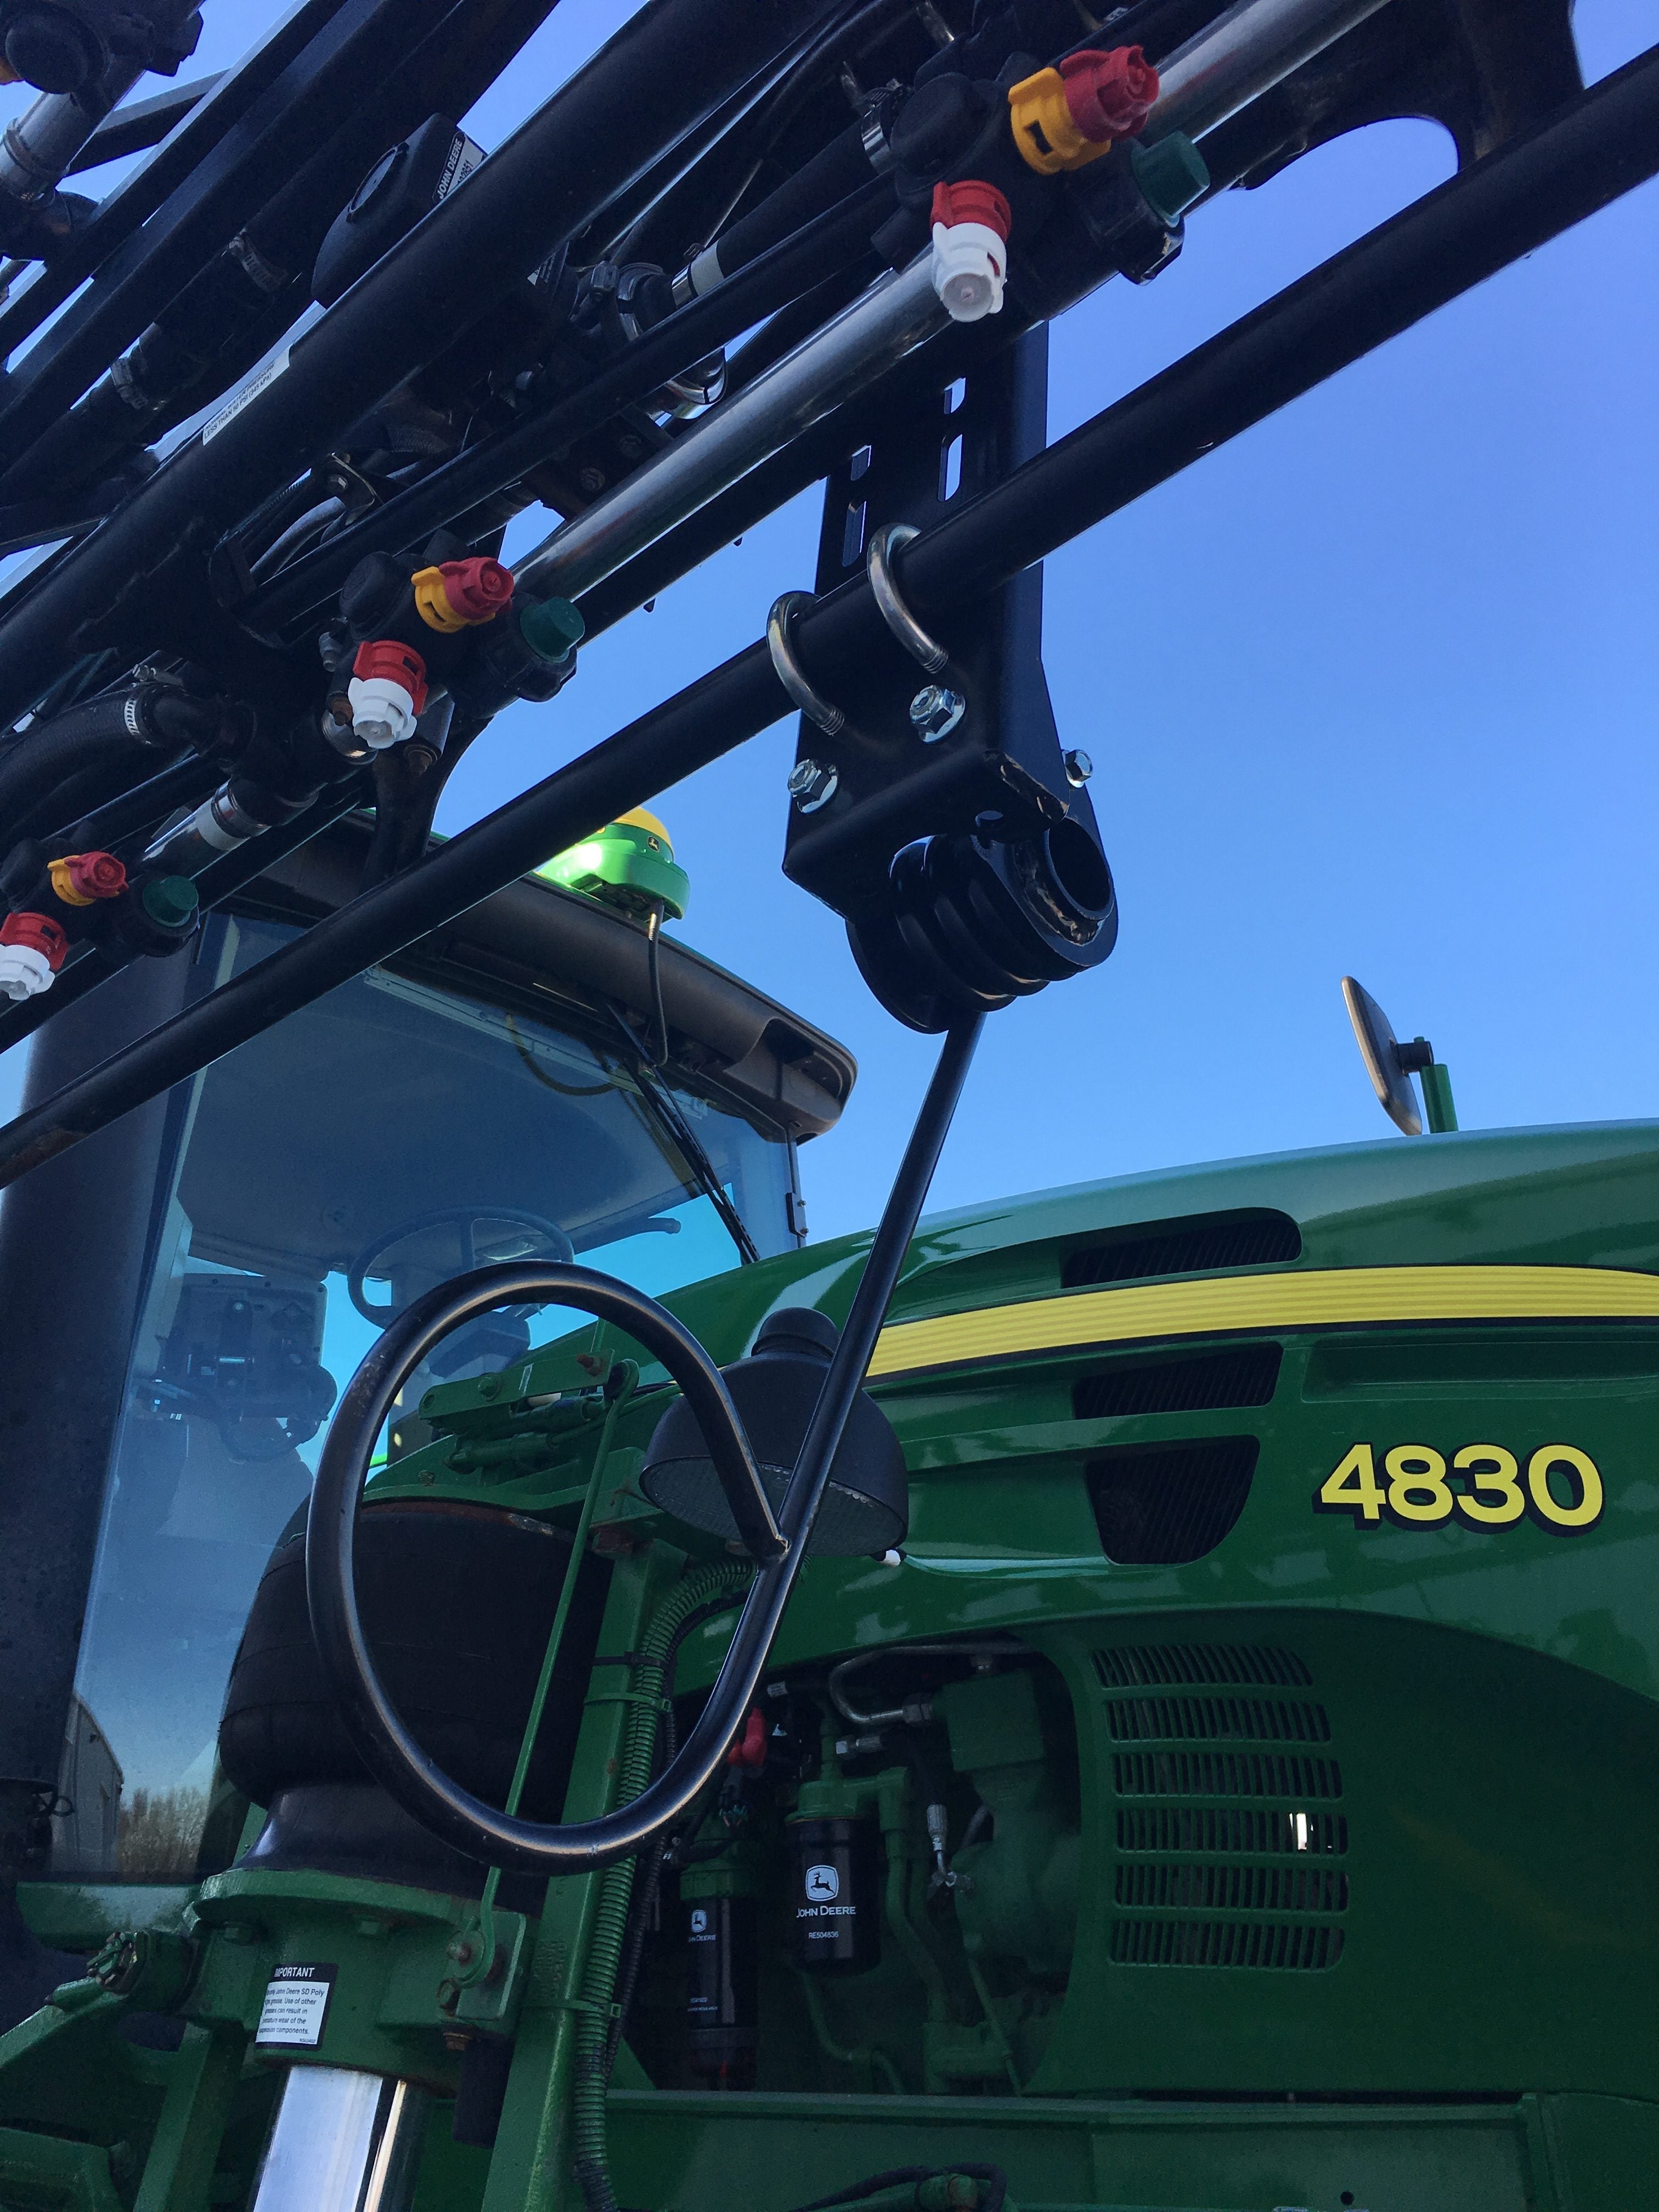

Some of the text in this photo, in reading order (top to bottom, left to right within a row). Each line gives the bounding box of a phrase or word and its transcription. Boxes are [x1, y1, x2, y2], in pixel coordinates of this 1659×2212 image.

[437, 138, 462, 200] JOHN DEERE
[204, 422, 217, 439] LESS
[218, 409, 232, 425] THAN
[240, 394, 248, 406] PSI
[1314, 1442, 1605, 1536] 4830
[796, 1905, 856, 1918] JOHN DEERE
[311, 1988, 325, 1997] Poly
